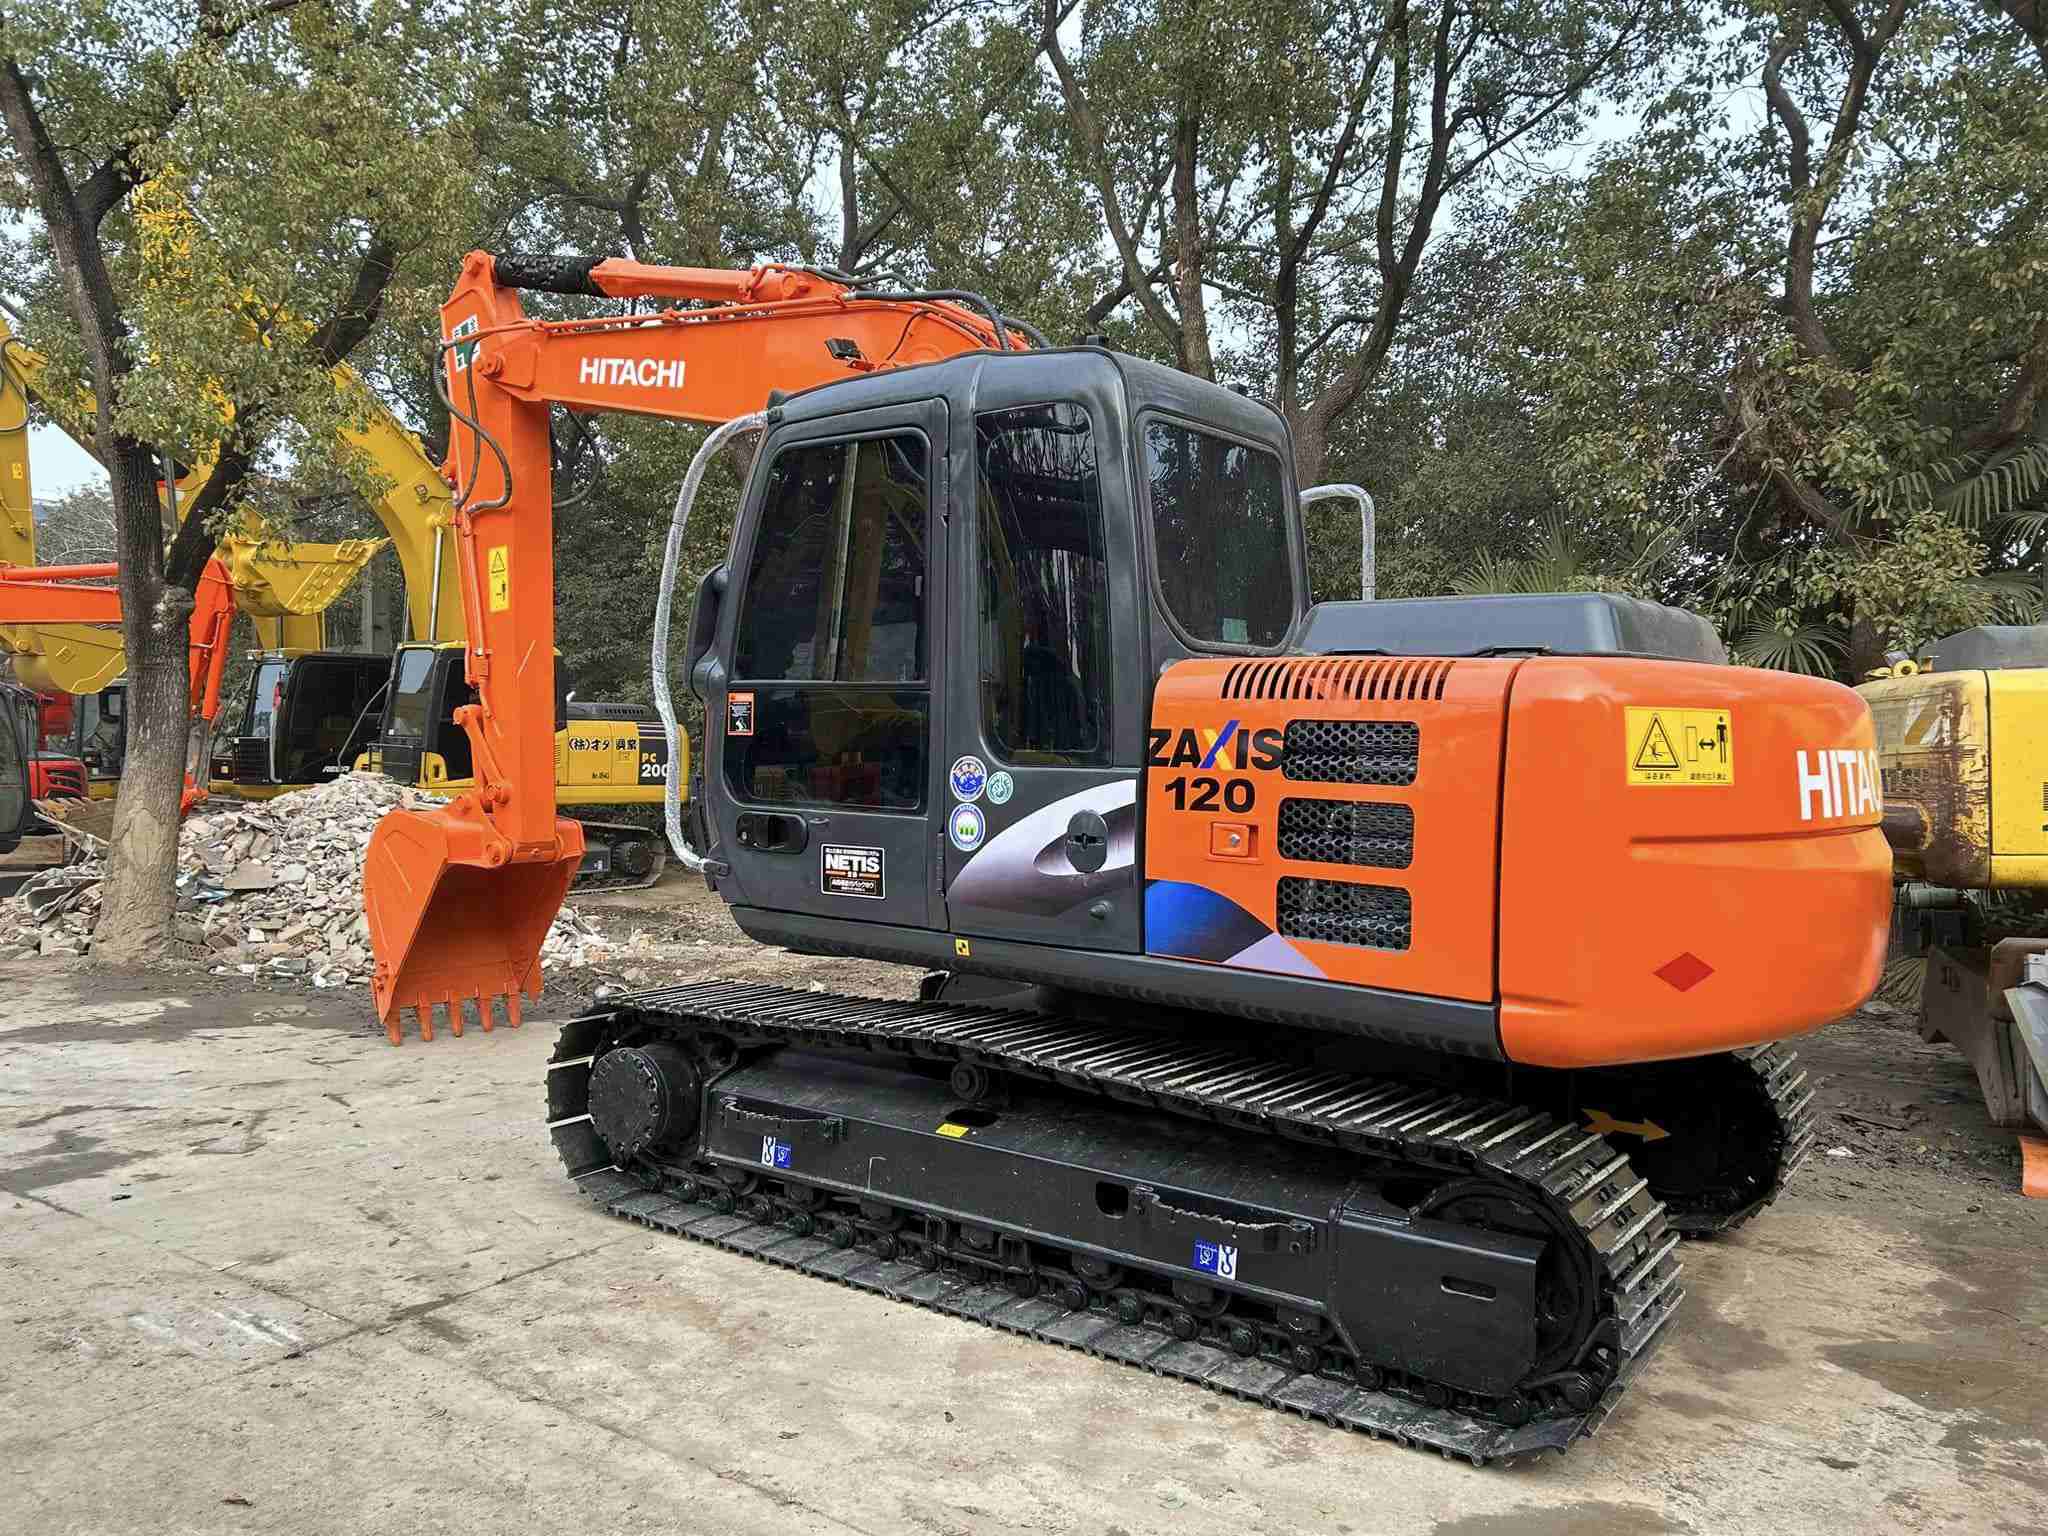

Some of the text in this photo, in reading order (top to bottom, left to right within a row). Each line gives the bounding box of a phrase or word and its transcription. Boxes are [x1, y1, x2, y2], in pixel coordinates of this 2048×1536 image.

[579, 357, 686, 388] HITACHI
[641, 752, 657, 762] PC
[1149, 719, 1282, 771] ZAXIS
[1164, 776, 1256, 813] 120
[825, 853, 881, 873] NETIS
